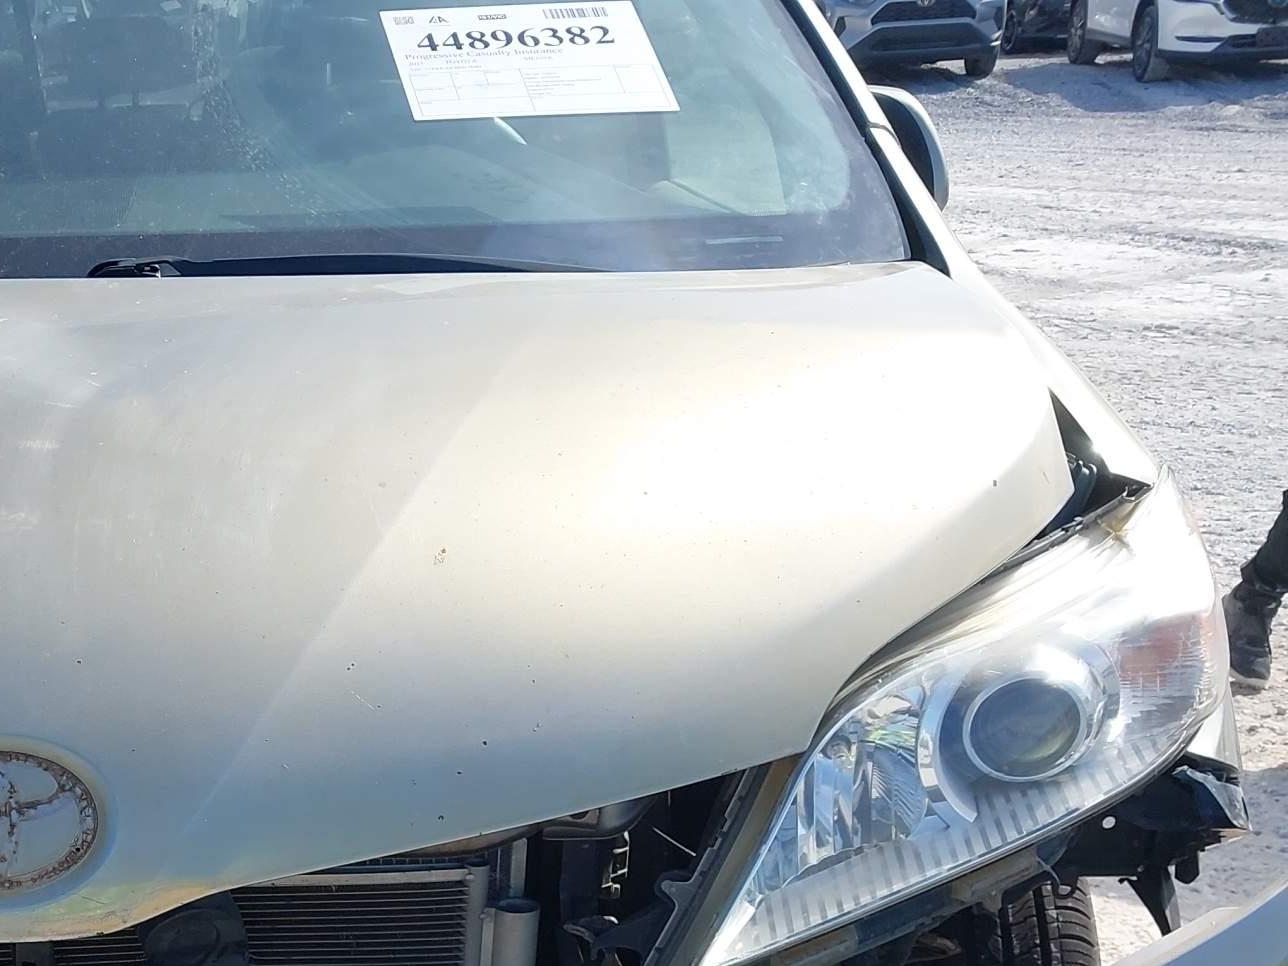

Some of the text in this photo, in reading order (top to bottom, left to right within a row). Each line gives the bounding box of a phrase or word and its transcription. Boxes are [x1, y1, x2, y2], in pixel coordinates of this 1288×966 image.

[417, 25, 616, 52] 44896382
[404, 47, 564, 61] Progressive Casualty Insurance
